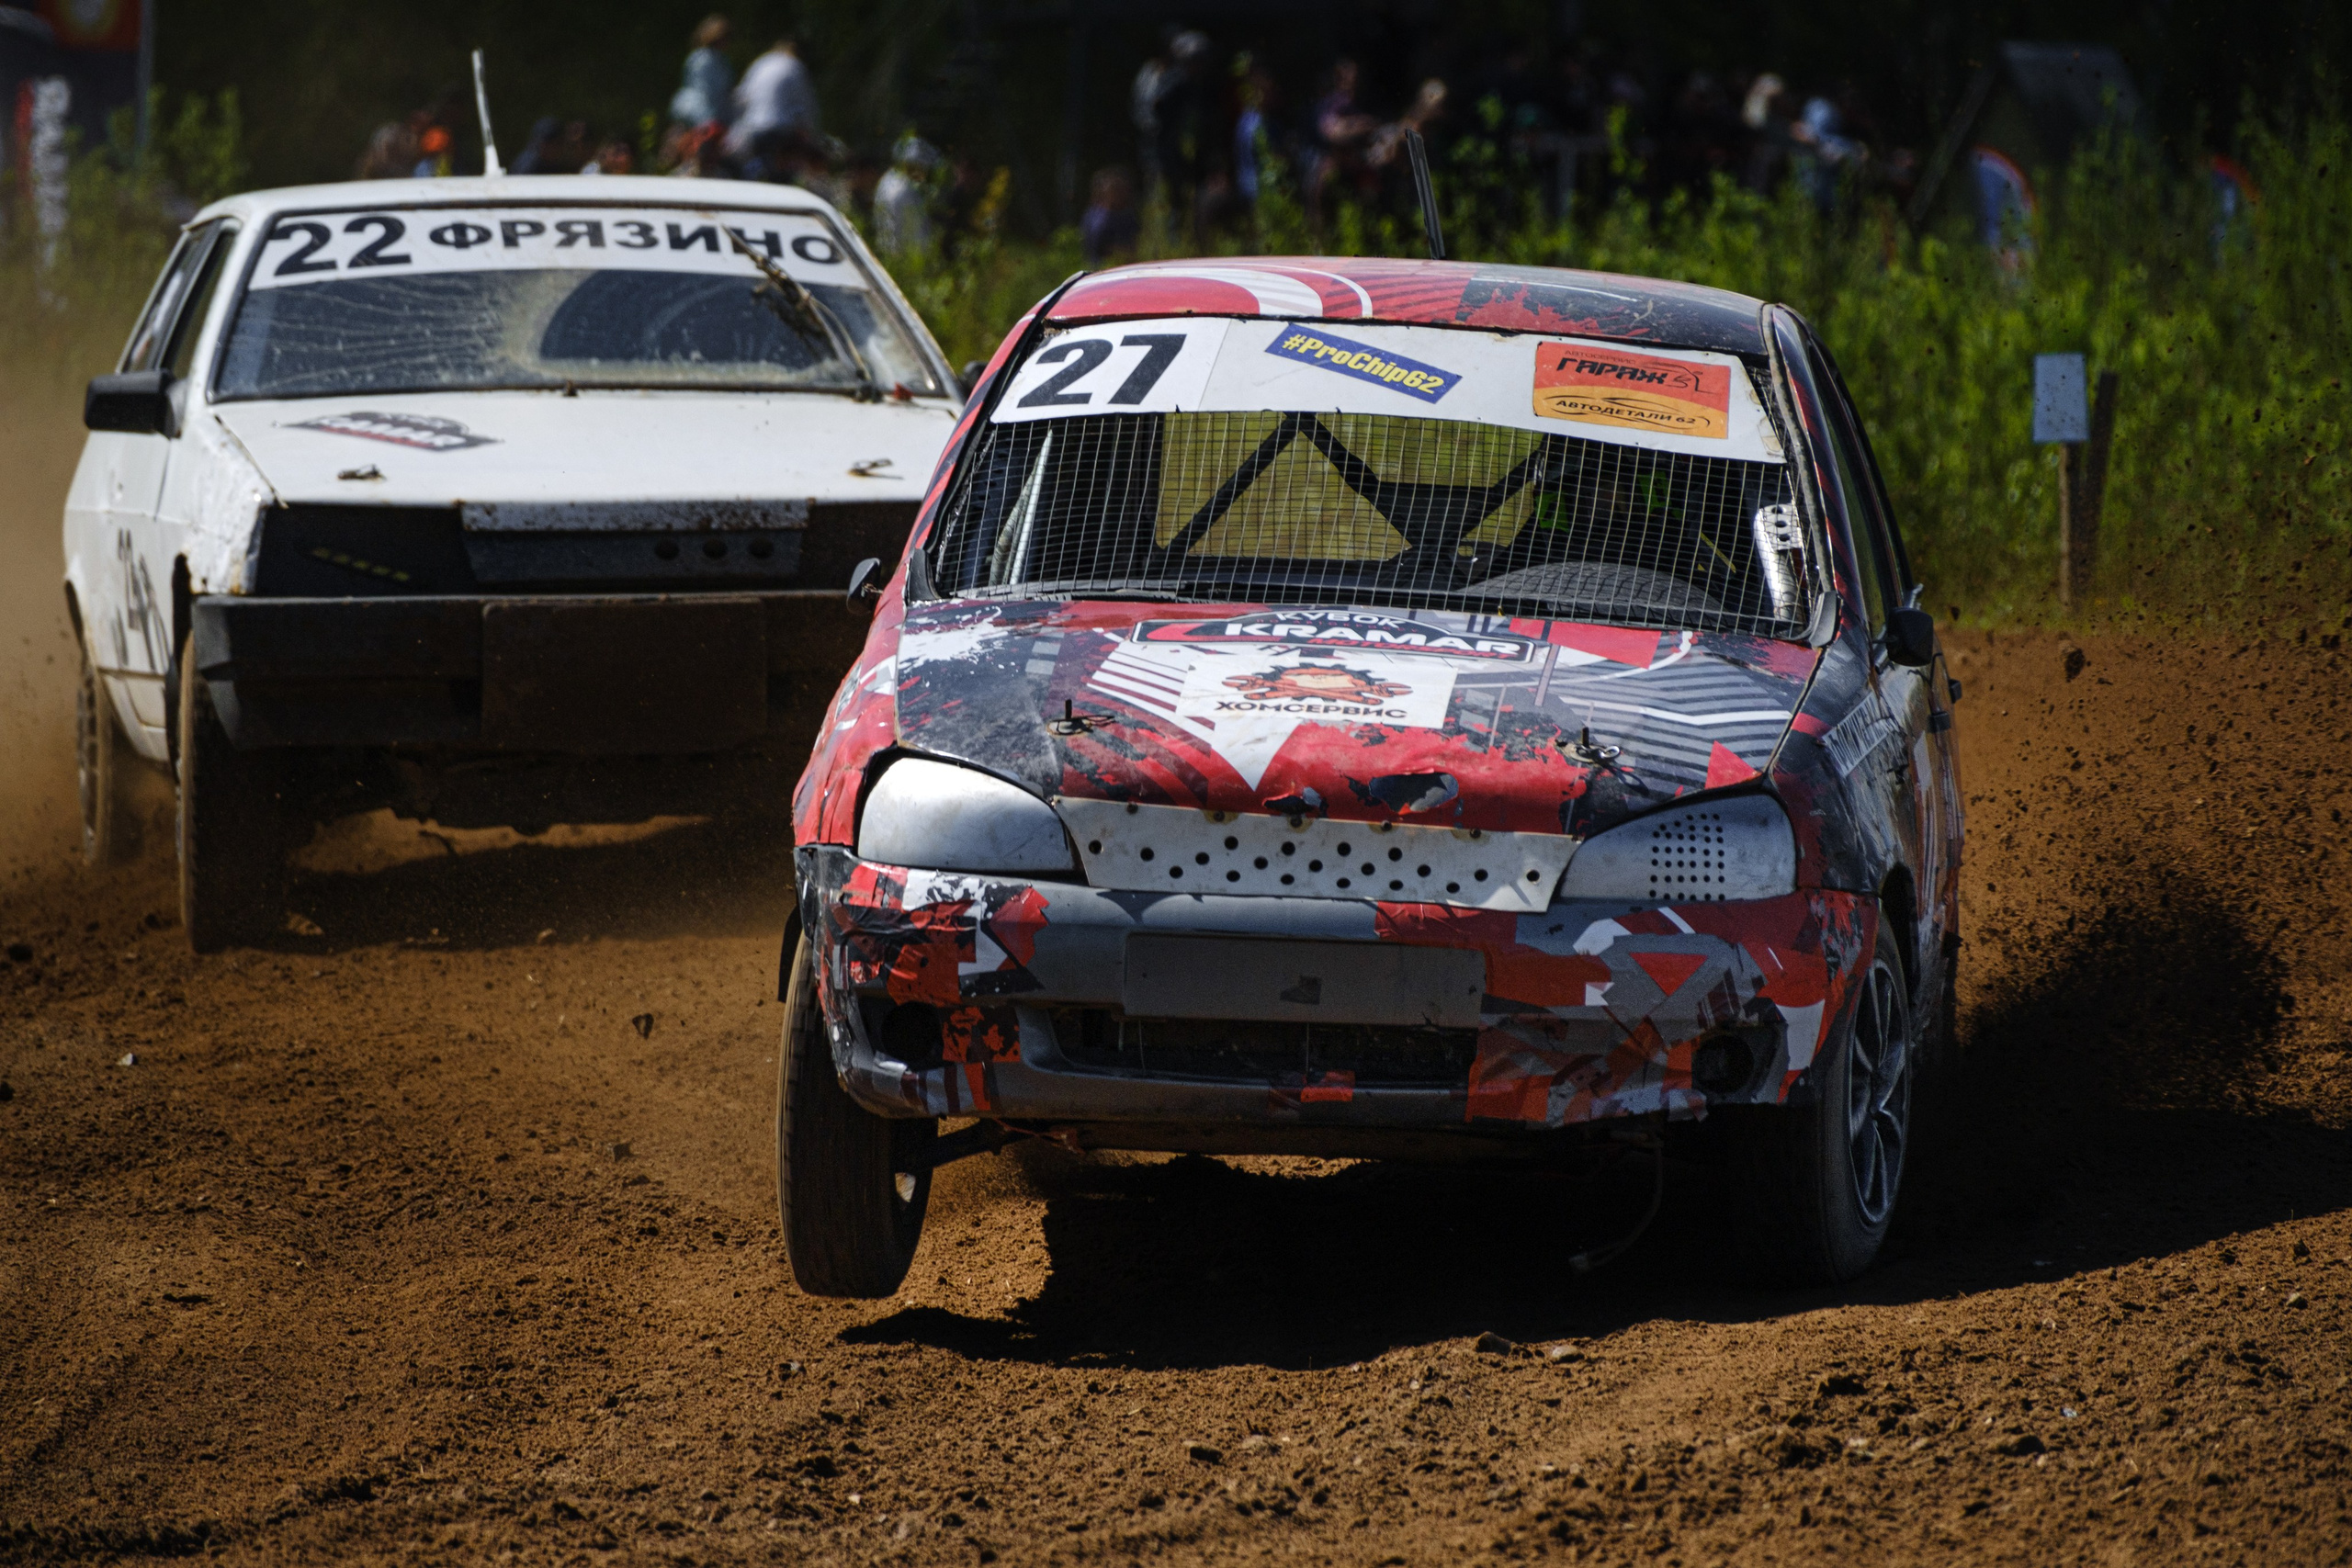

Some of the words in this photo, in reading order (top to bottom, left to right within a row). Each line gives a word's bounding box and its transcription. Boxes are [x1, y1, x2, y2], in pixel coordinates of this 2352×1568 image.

[267, 215, 412, 276] 22
[429, 220, 846, 265] ФРЯЗИНО
[1016, 333, 1188, 409] 27
[1282, 333, 1445, 395] #ProChip62
[1556, 357, 1668, 384] ГАРАЖ
[1565, 350, 1636, 365] АВТОСЕРВИС
[1556, 400, 1672, 422] АВТОДЕТАЛИ
[1275, 612, 1406, 628] КУБОК
[1225, 623, 1521, 655] KRAMAR
[1215, 701, 1408, 718] ХОМСЕРВИС
